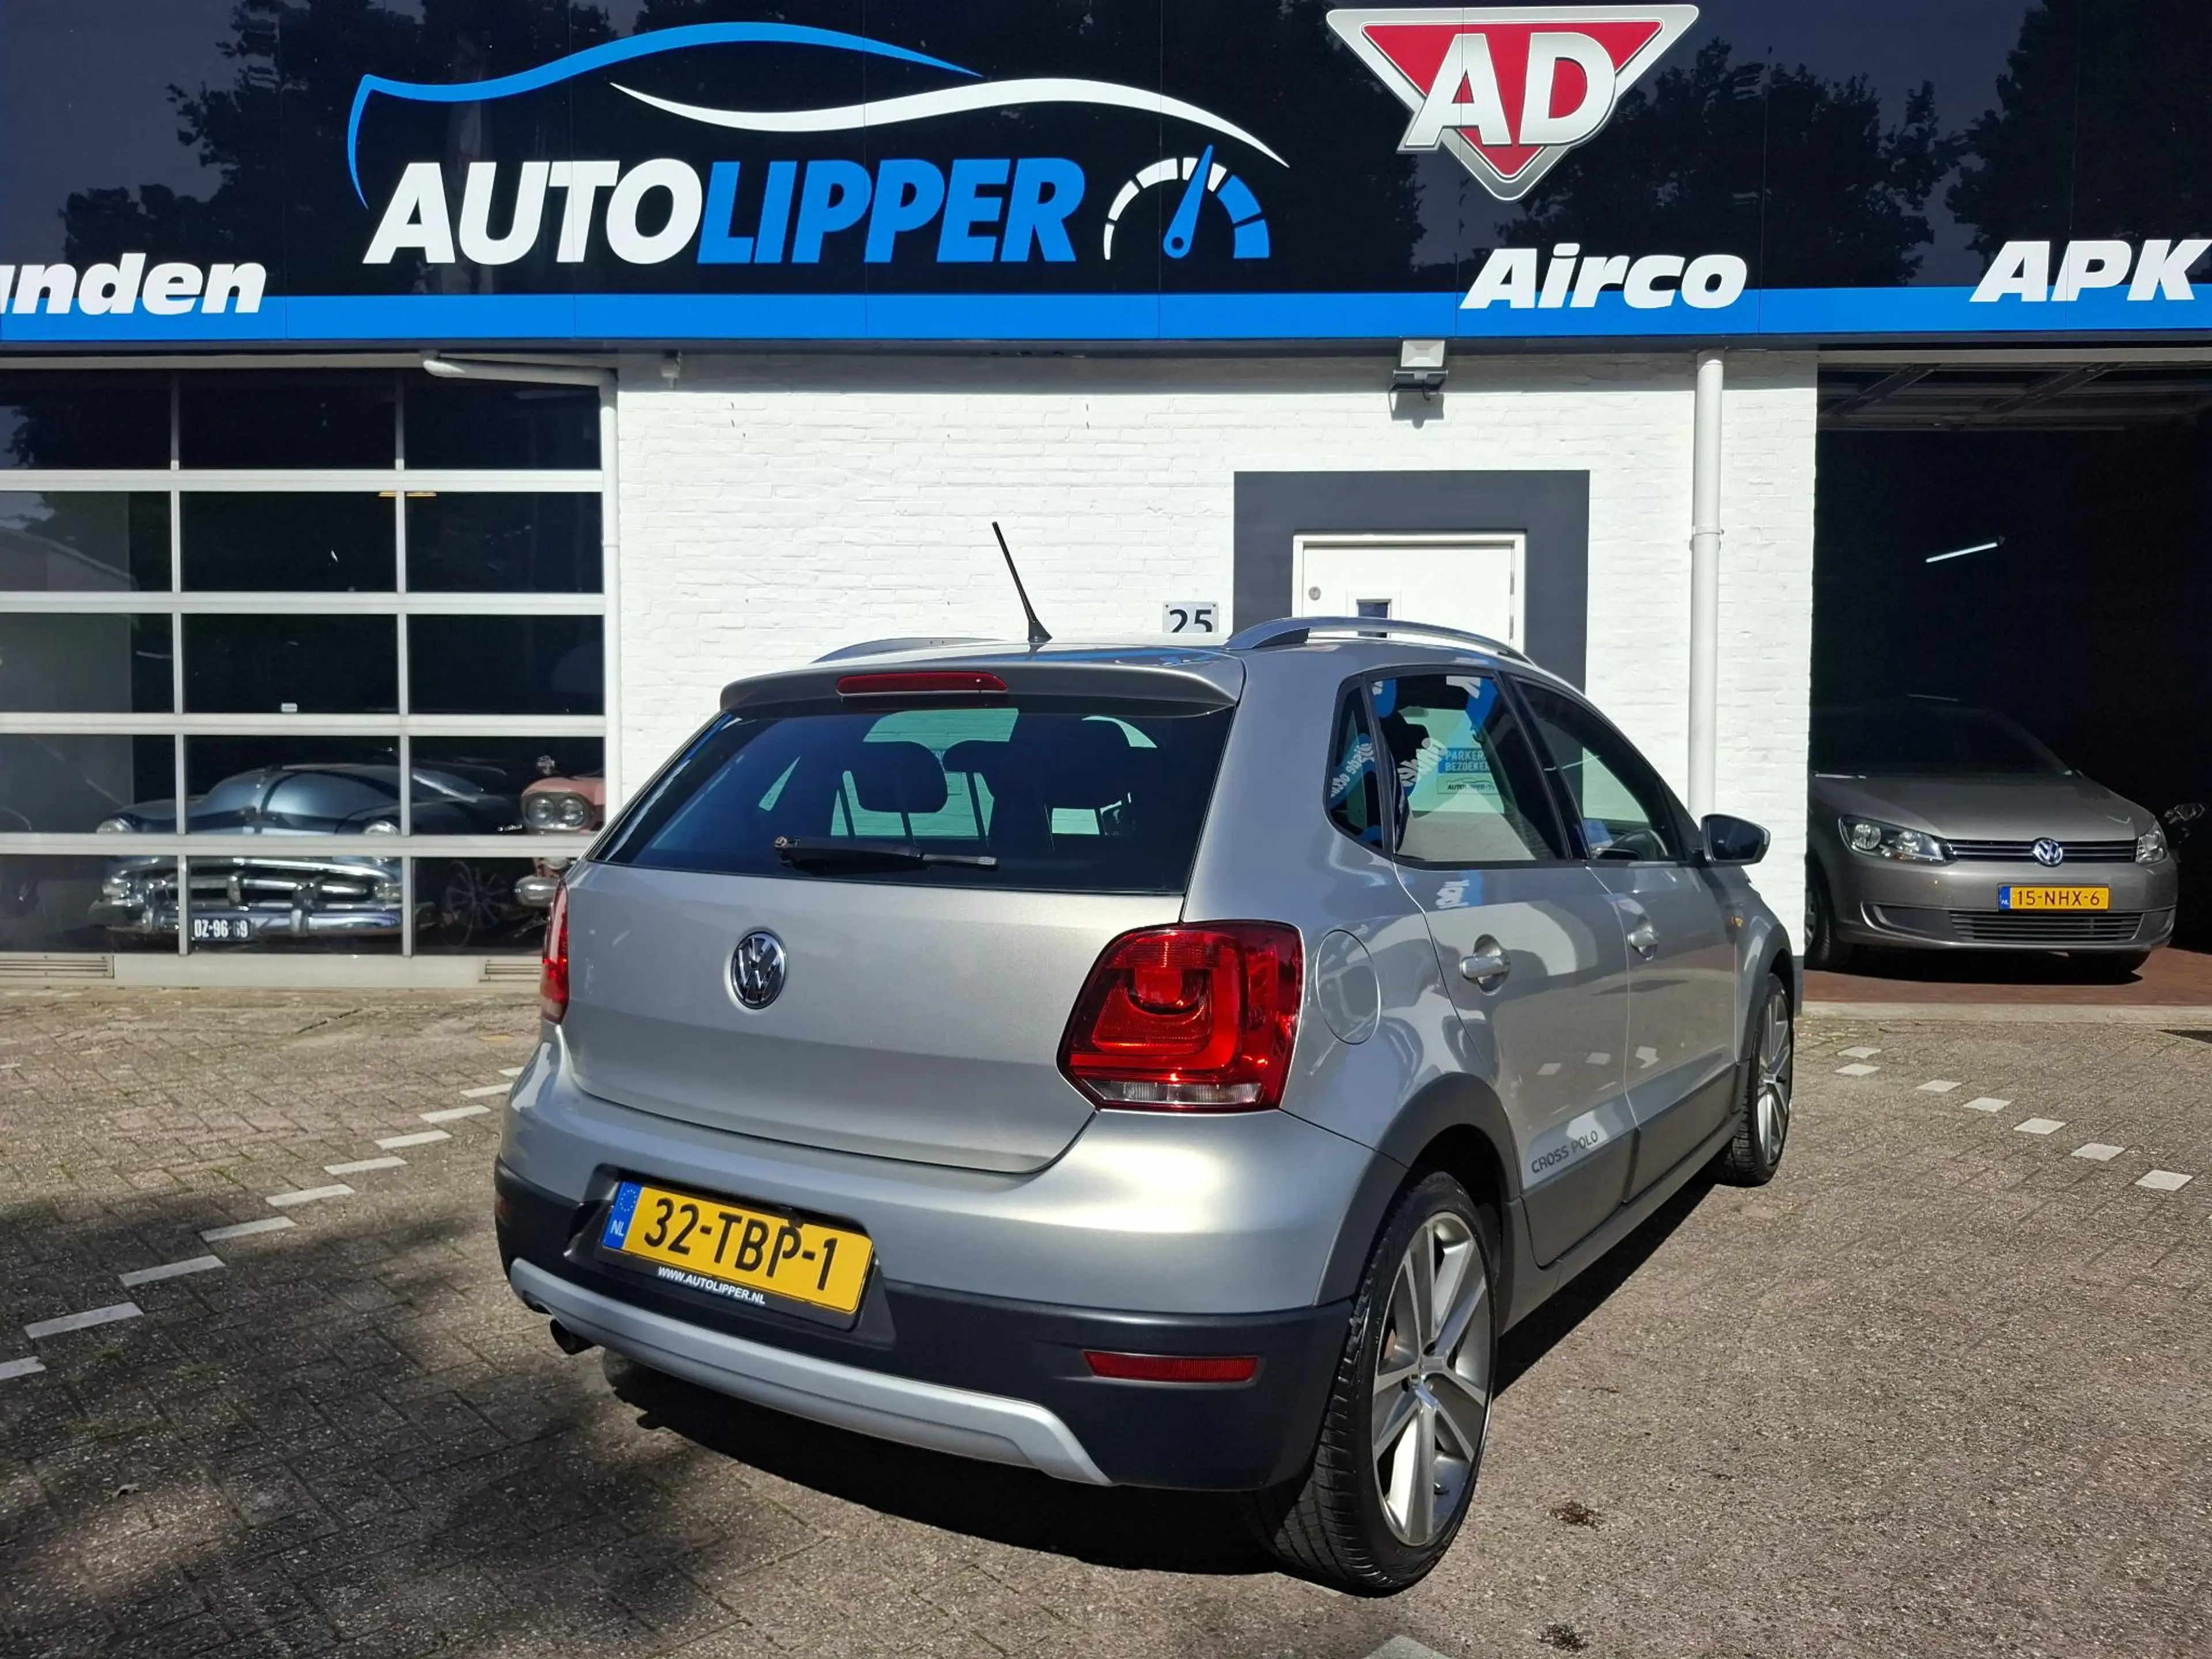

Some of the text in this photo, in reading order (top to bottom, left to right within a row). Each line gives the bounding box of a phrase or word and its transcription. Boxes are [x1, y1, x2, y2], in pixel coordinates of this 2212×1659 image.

[1397, 32, 1616, 151] AD
[362, 157, 1086, 266] AUTOLIPPER
[1460, 243, 1748, 309] Airco
[1969, 239, 2212, 302] APK
[1169, 609, 1213, 633] 25
[1444, 750, 1486, 761] PARKER
[2017, 890, 2100, 906] 15-NHX-6
[1531, 1130, 1598, 1173] CROSS POLO
[610, 1219, 625, 1238] NL
[644, 1196, 839, 1291] 32-TBP-1
[657, 1266, 766, 1305] WWW.AUTOLIPPER.NL
